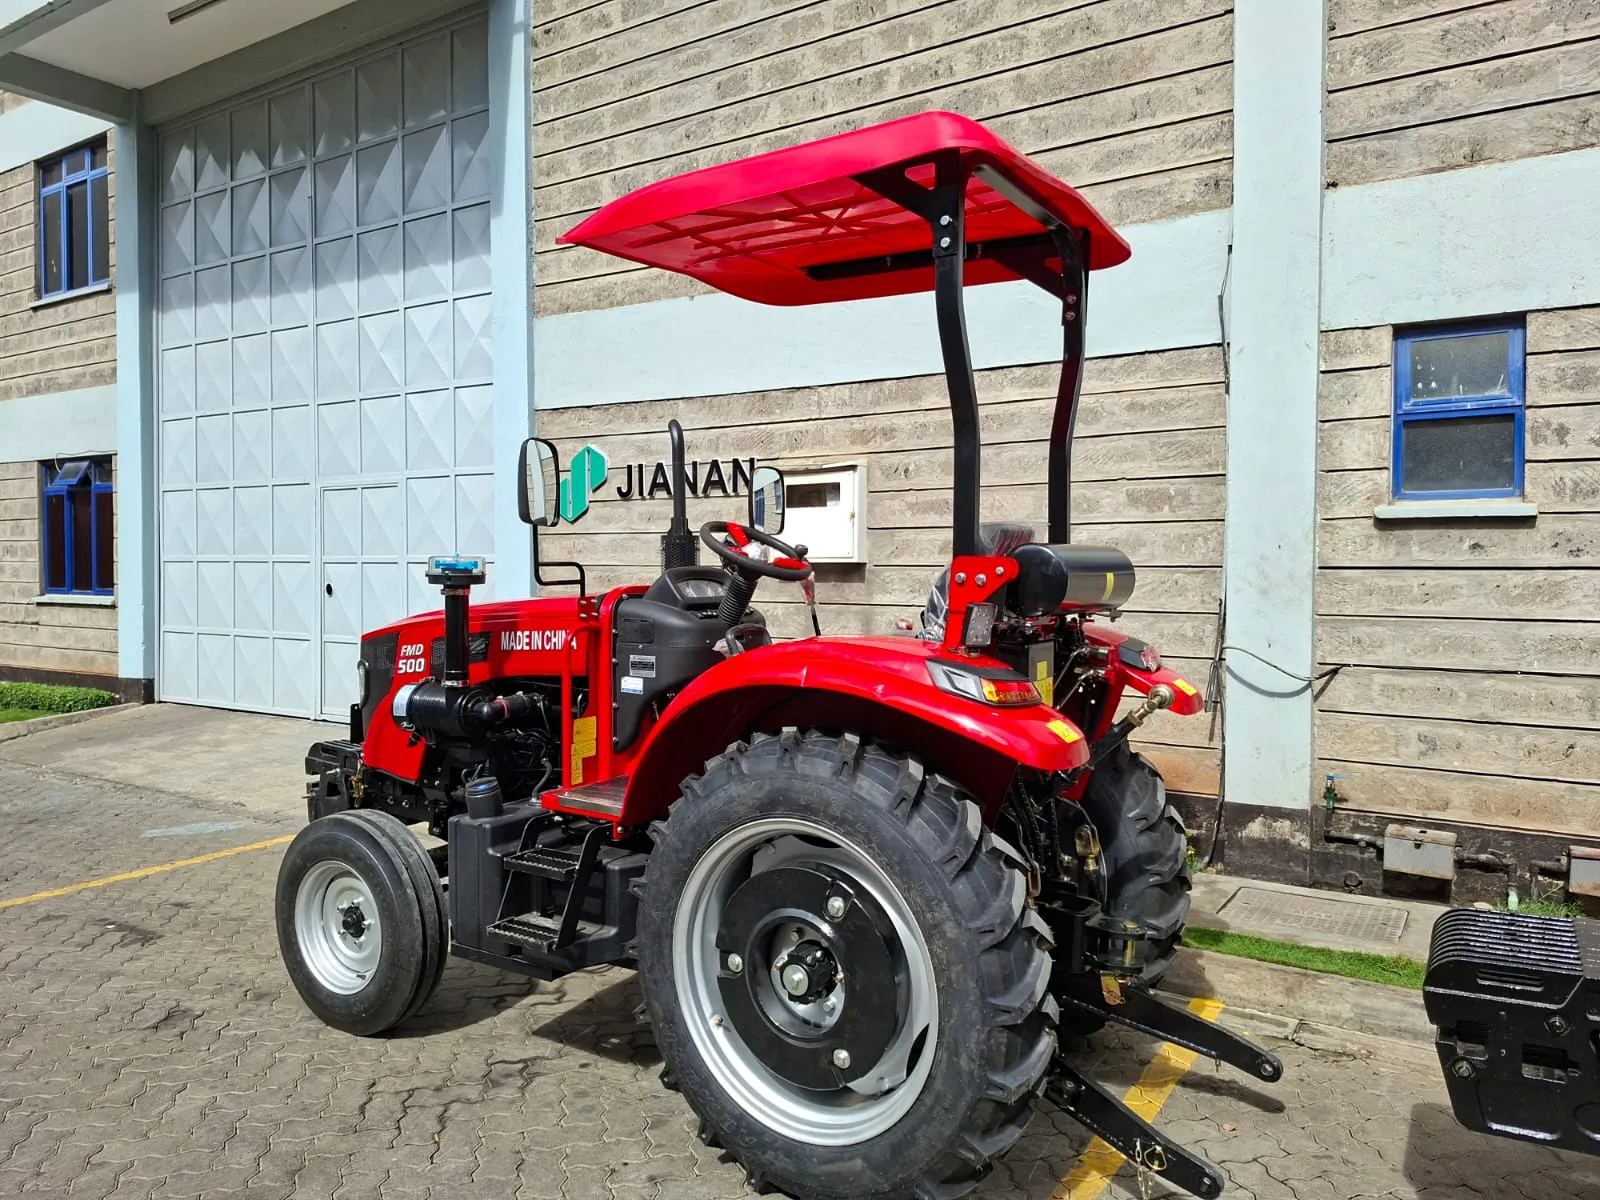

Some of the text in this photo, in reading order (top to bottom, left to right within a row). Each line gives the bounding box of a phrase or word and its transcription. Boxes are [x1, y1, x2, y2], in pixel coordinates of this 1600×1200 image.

[616, 457, 756, 499] JIANAN
[501, 630, 530, 651] MADE
[531, 630, 542, 650] IN
[400, 643, 424, 657] FMD
[397, 658, 425, 674] 500
